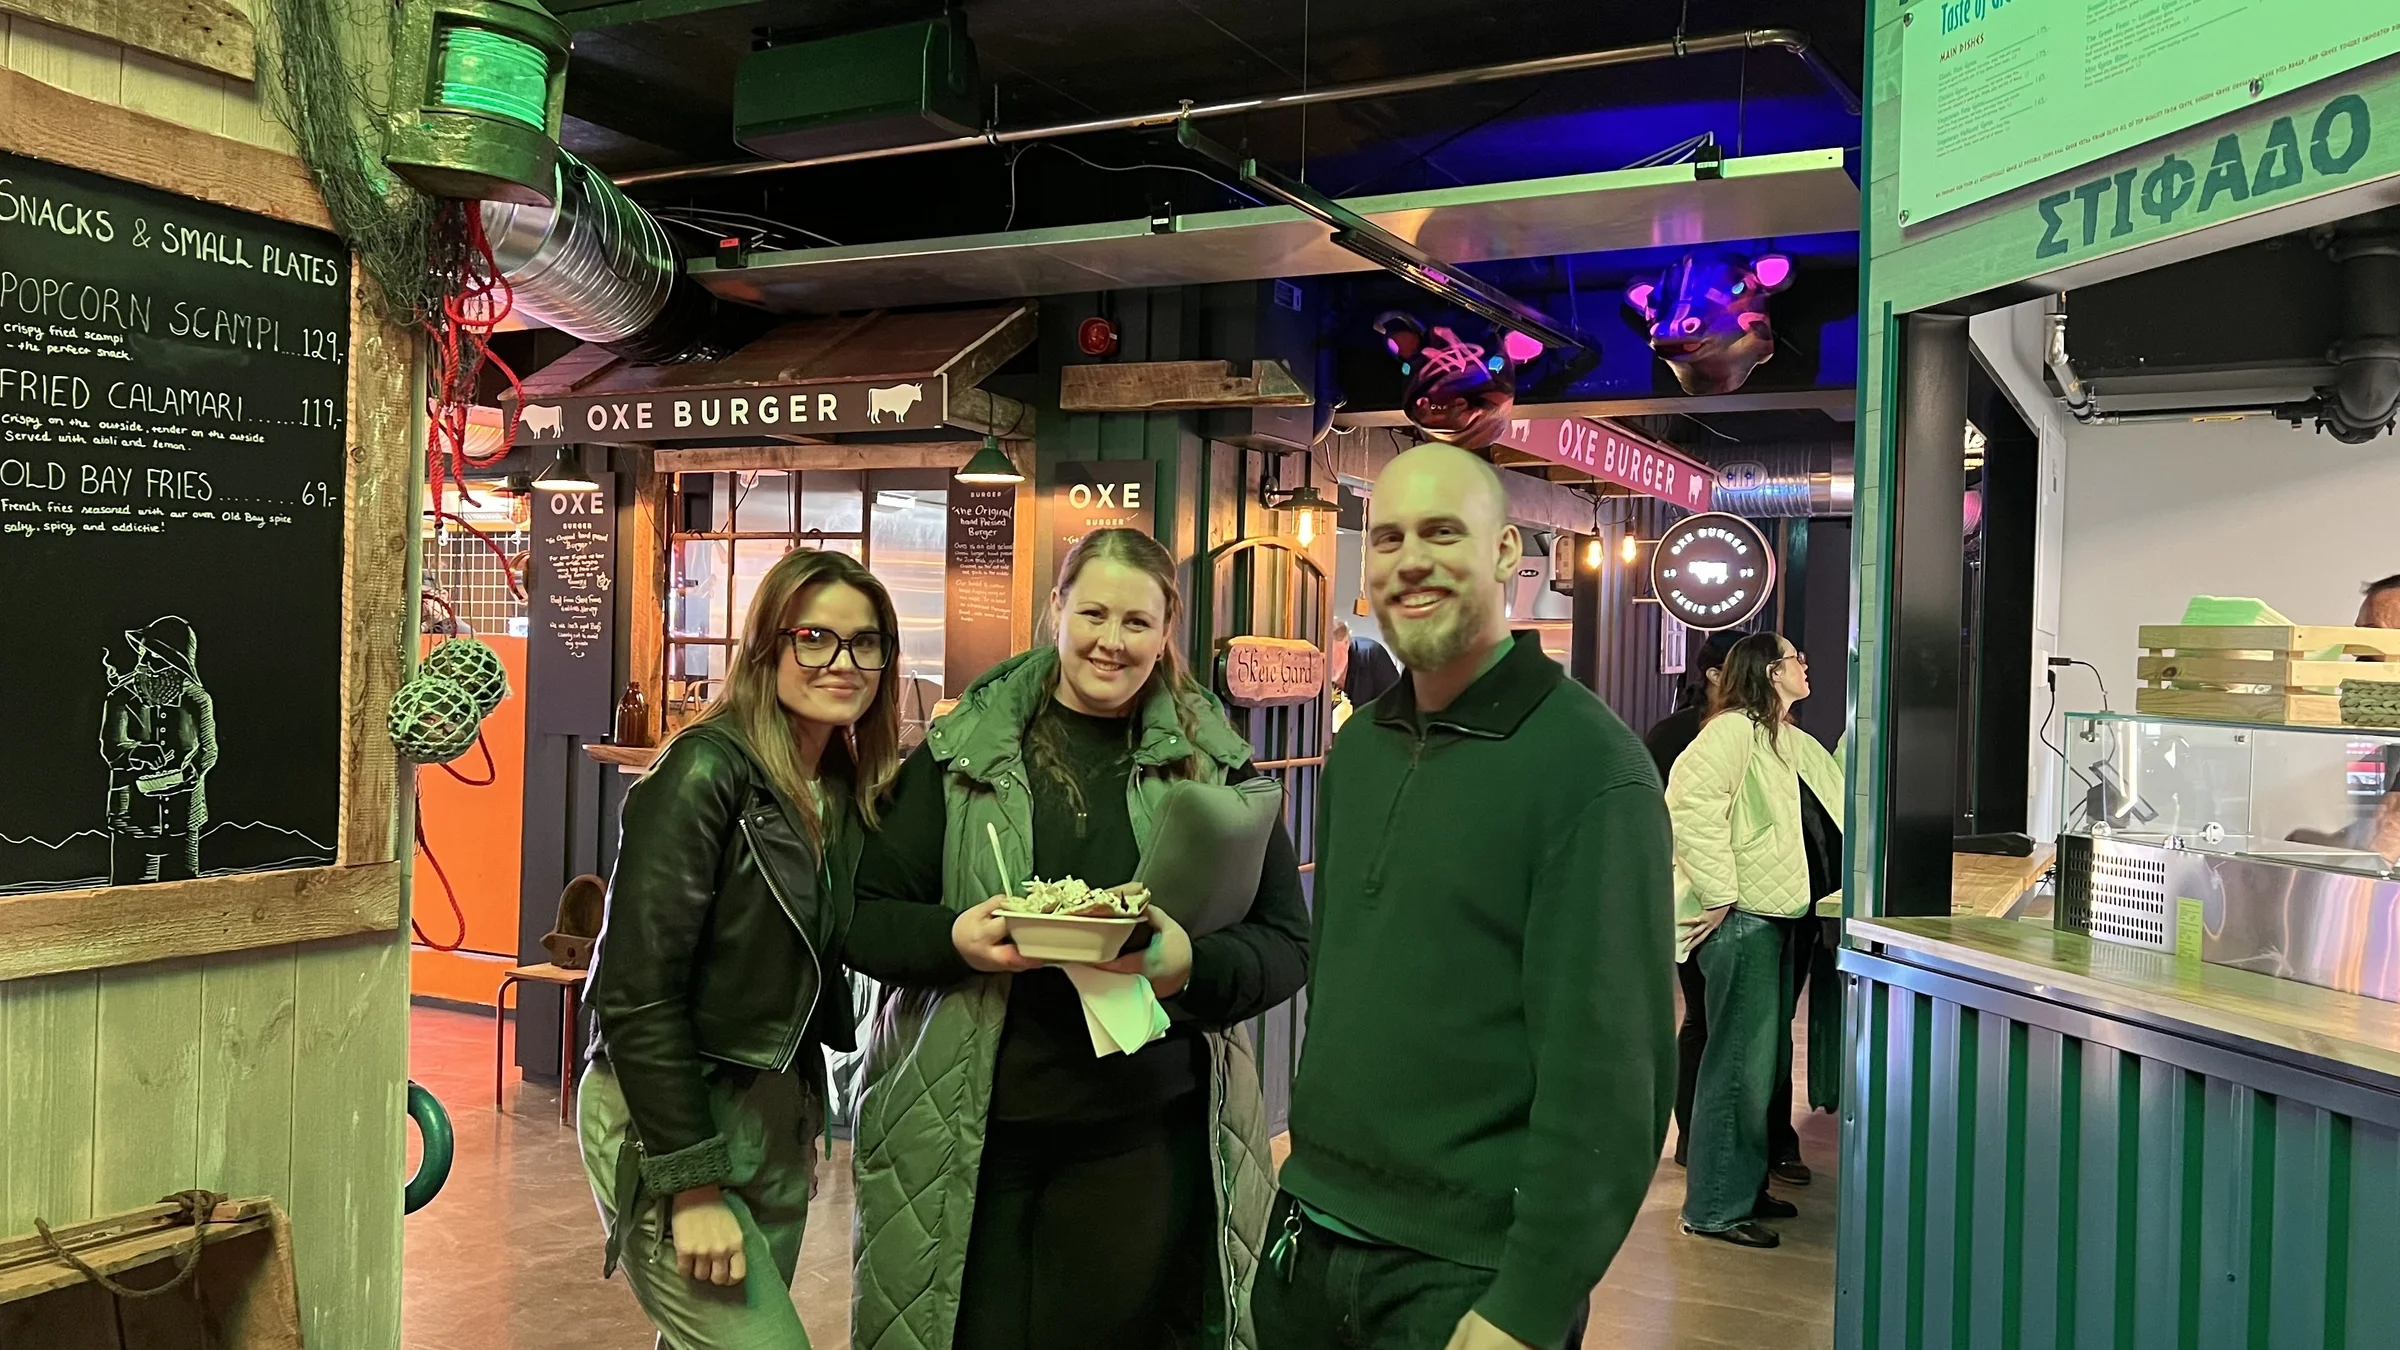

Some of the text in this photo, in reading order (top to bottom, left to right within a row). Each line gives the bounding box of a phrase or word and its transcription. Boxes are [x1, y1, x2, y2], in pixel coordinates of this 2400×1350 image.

[1942, 0, 1970, 35] Taste
[1940, 32, 1984, 63] MAIN DISHES
[2035, 94, 2371, 259] ΣΤΙΦΑΔΟ
[0, 179, 338, 286] SNACKS & SMALL PLATES
[0, 271, 150, 333] POPCORN
[169, 302, 279, 352] SCAMPI
[3, 322, 123, 346] crispy fried scampi
[18, 341, 40, 351] the
[47, 345, 91, 355] perfect
[0, 368, 90, 410] FRIED
[108, 381, 242, 422] CALAMARI
[587, 393, 838, 432] OXE BURGER
[1, 413, 42, 430] Crispy
[48, 417, 64, 426] on
[69, 419, 90, 428] the
[152, 425, 188, 434] tender
[191, 429, 204, 437] on
[208, 430, 225, 439] the
[229, 433, 265, 443] outside
[5, 430, 52, 441] Served
[58, 432, 87, 444] with
[93, 435, 117, 446] aioli
[121, 437, 147, 447] and
[1558, 418, 1676, 495] OXE BURGER
[0, 459, 65, 491] OLD
[81, 464, 132, 496] BAY
[147, 468, 213, 501] FRIES
[550, 491, 604, 515] OXE
[1069, 483, 1141, 509] OXE
[1, 499, 42, 512] French
[47, 501, 73, 513] fries
[81, 505, 131, 515] seasoned
[138, 507, 164, 516] with
[221, 512, 241, 521] Old
[245, 512, 266, 529] Bay
[269, 513, 292, 526] spice
[562, 522, 592, 530] BURGER
[975, 504, 1012, 520] Original
[1085, 518, 1124, 526] BURGER
[43, 521, 77, 536] spicy
[82, 522, 106, 531] and
[111, 521, 166, 533] addictive!
[968, 527, 998, 540] Burger
[1671, 532, 1695, 555] OXE
